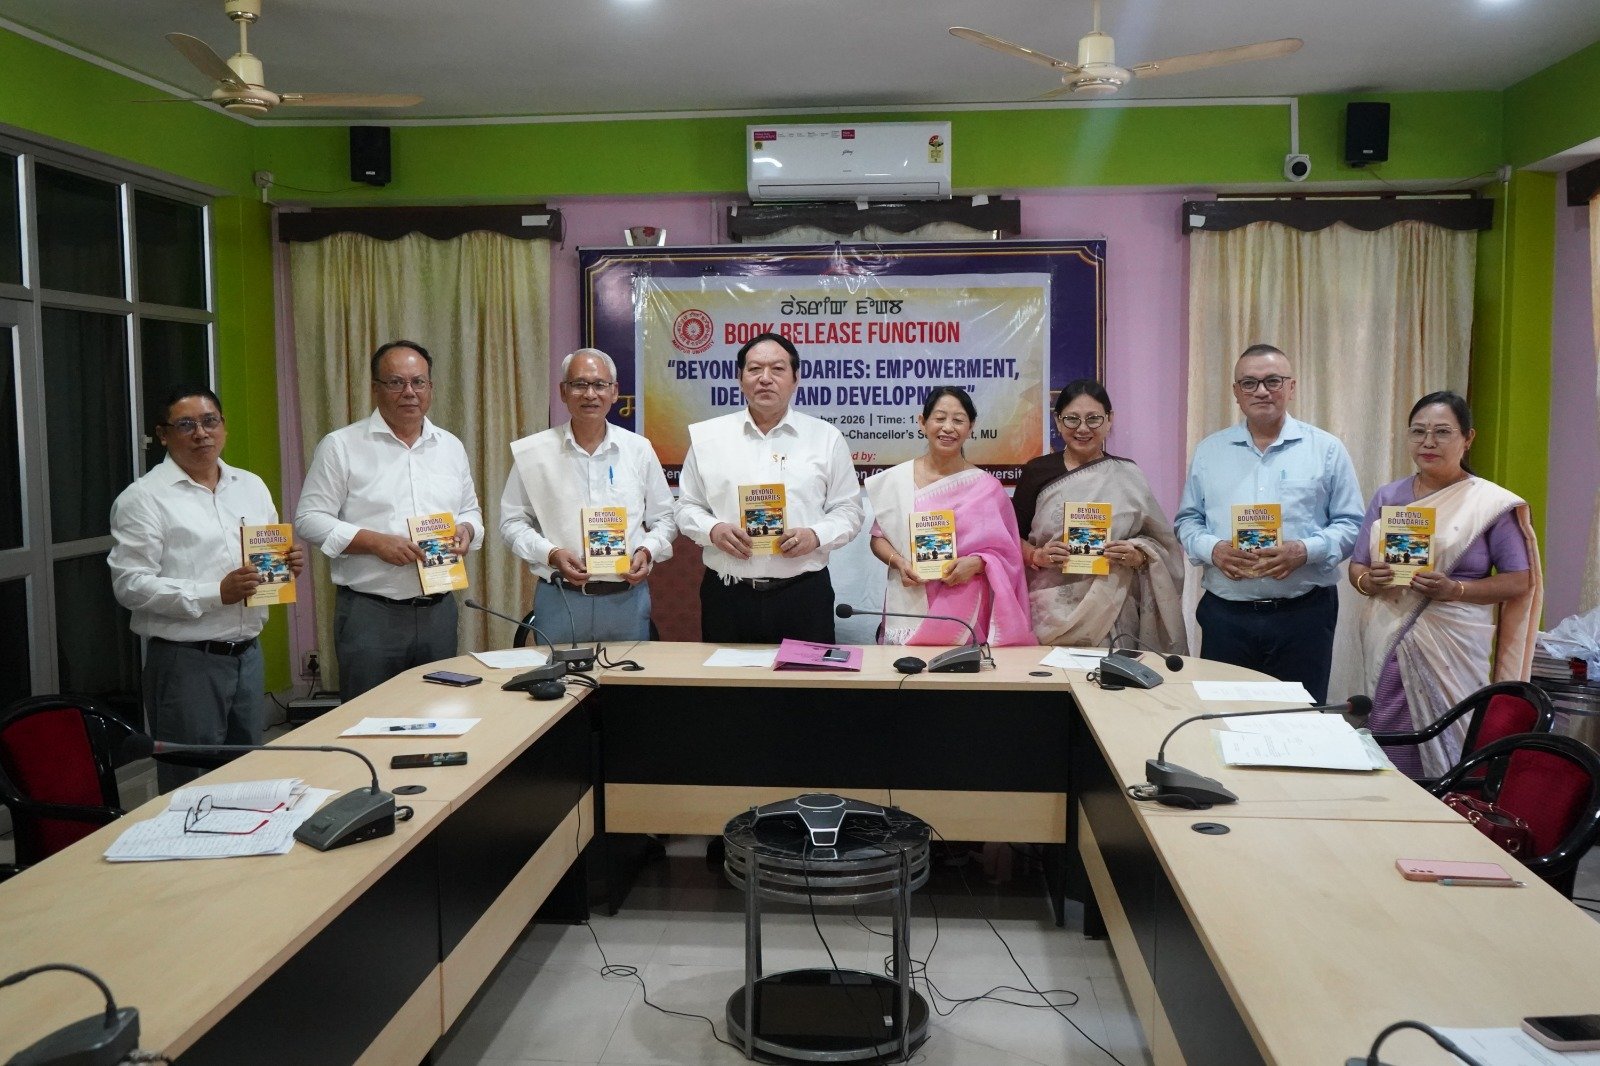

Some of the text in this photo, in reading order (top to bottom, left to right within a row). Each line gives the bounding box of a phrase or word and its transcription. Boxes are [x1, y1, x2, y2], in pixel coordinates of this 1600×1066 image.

[724, 322, 774, 345] BOOK
[780, 321, 862, 344] RELEASE
[868, 321, 960, 344] FUNCTION
[876, 358, 1020, 381] EMPOWERMENT,
[794, 386, 832, 406] AND
[840, 415, 865, 425] 2026
[877, 415, 906, 424] Time:
[981, 430, 997, 440] MU
[861, 451, 877, 462] by:
